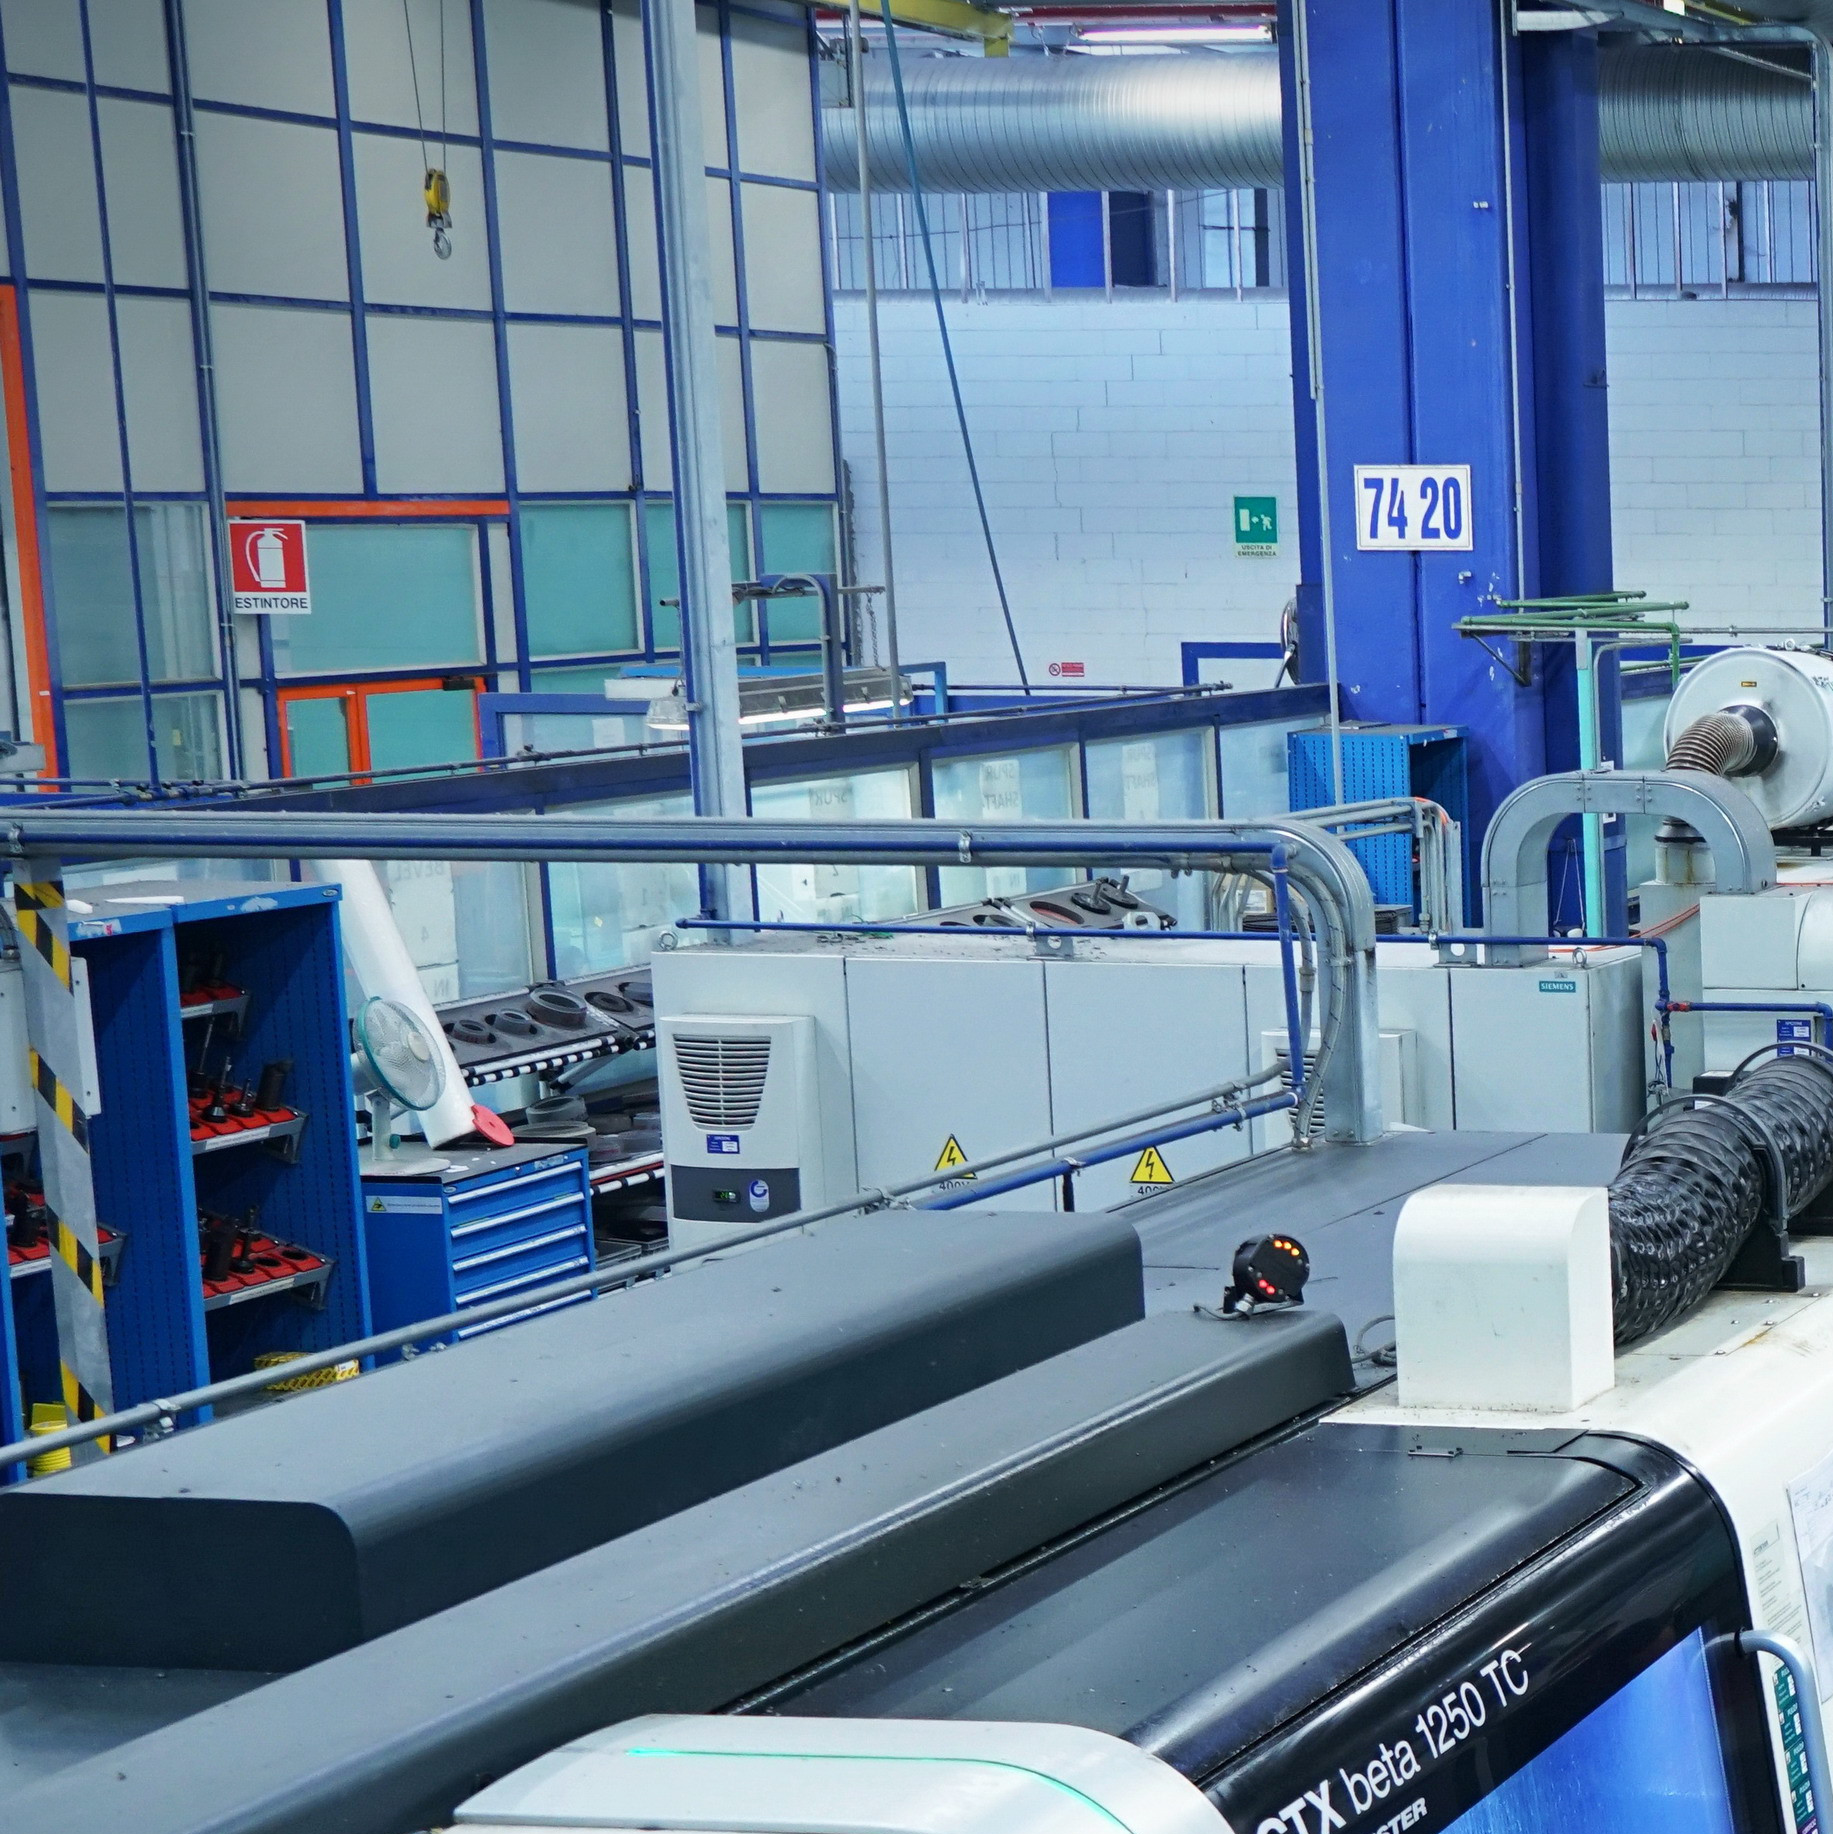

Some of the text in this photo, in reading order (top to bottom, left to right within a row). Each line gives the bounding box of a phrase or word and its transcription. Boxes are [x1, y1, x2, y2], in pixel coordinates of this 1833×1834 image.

[1363, 476, 1463, 540] 74 20
[235, 597, 309, 609] ESTINTORE
[1541, 982, 1574, 991] SIEMENS
[1339, 1740, 1422, 1816] beta
[1415, 1681, 1487, 1759] 1250
[1480, 1649, 1529, 1708] TC
